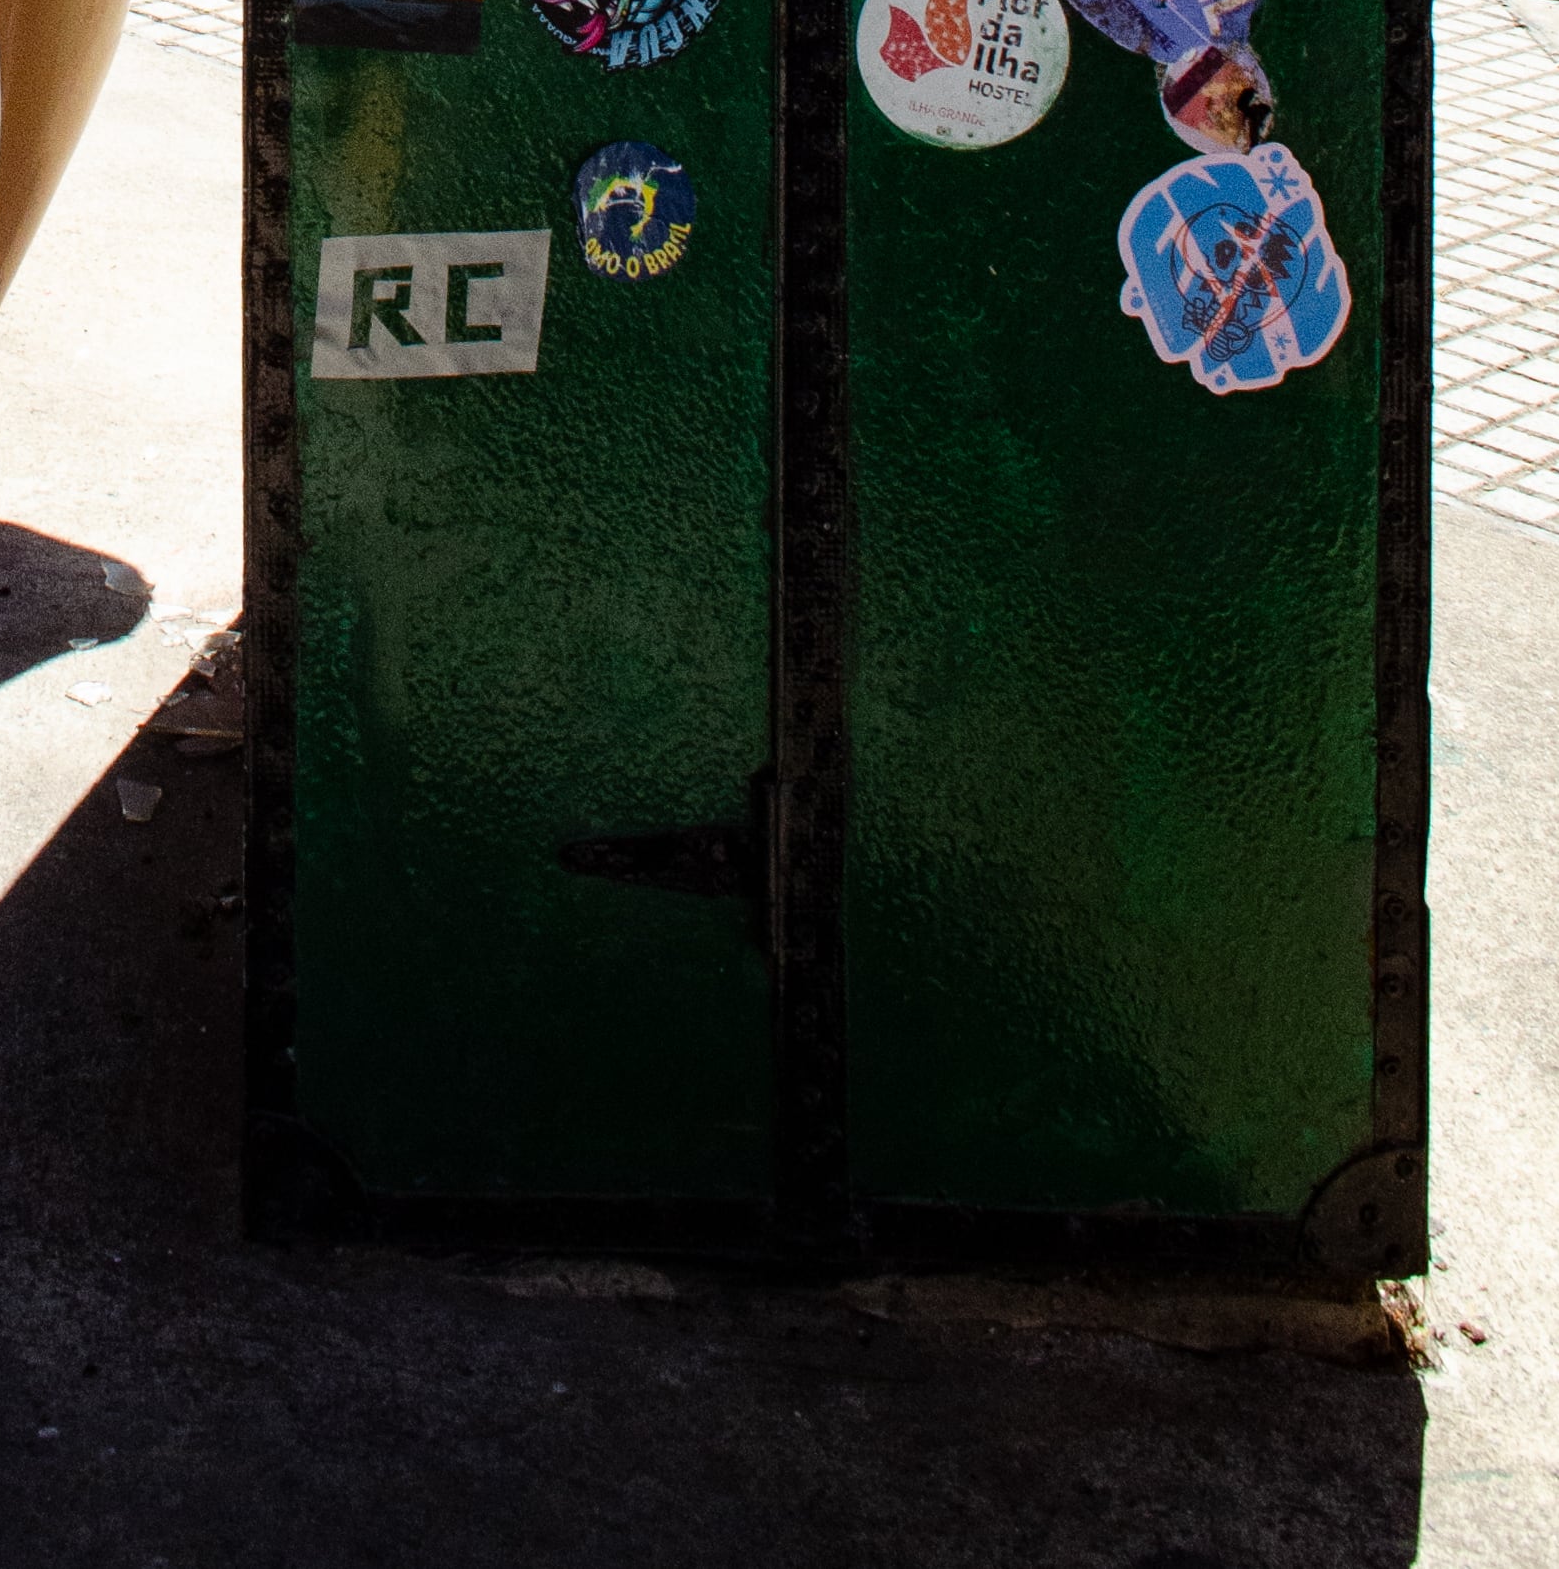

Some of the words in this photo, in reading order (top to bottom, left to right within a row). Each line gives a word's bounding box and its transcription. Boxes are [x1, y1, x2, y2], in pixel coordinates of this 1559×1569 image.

[980, 13, 1023, 48] da
[973, 43, 1041, 85] Ilha
[968, 79, 1033, 108] HOSTEL
[626, 255, 641, 280] O
